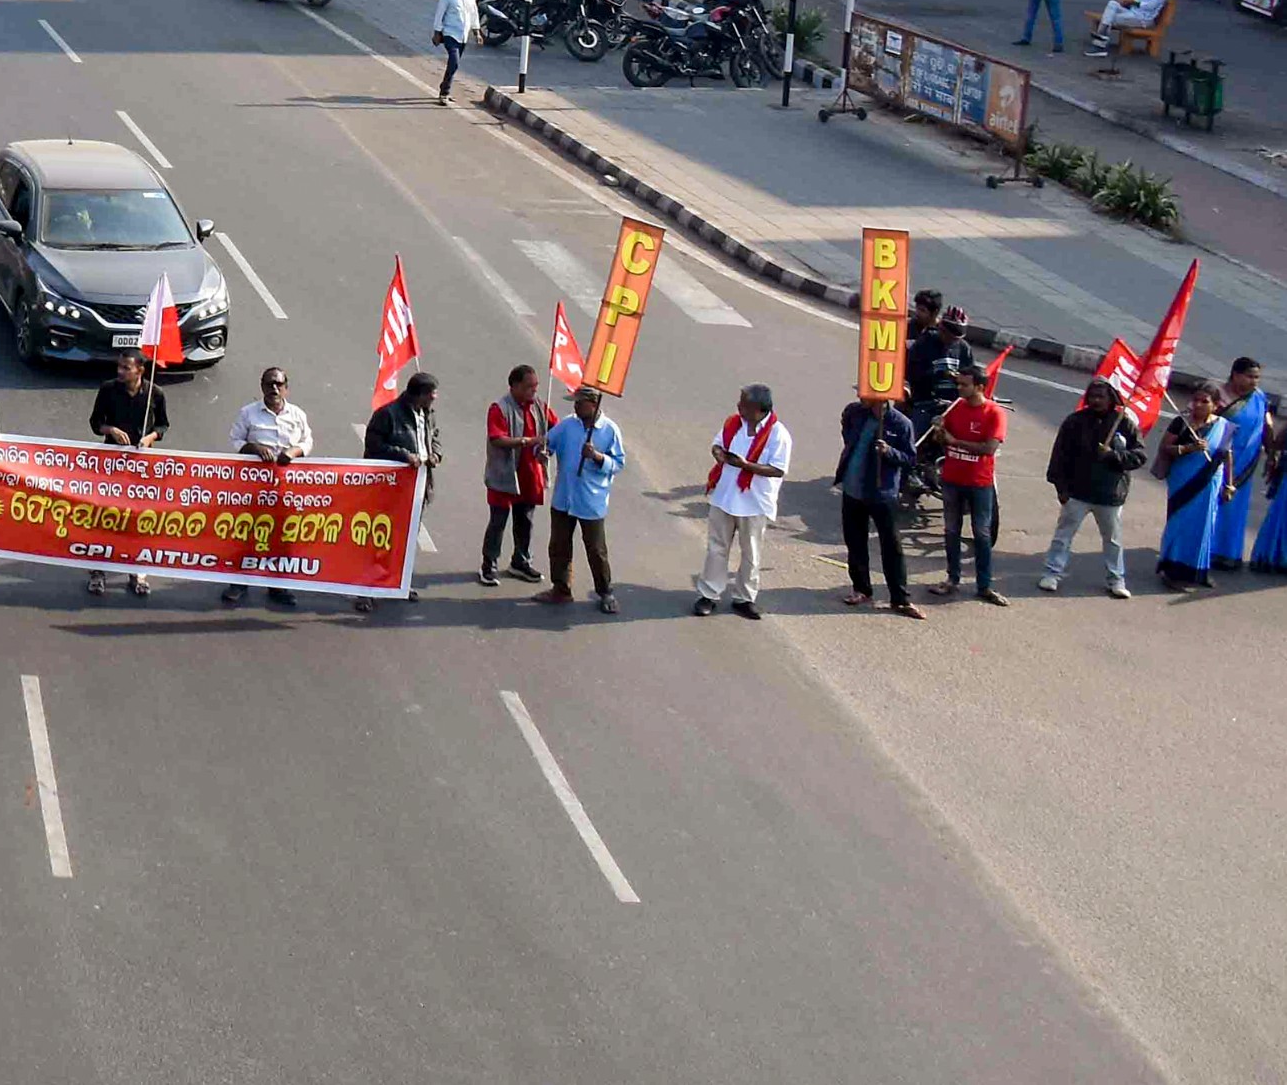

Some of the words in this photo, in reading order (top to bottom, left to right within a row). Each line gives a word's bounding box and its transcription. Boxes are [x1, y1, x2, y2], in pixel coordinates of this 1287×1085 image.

[988, 112, 1020, 137] airtel
[597, 231, 655, 384] CPI
[868, 237, 898, 392] BKMU
[68, 479, 94, 496] ନାମ
[97, 481, 123, 498] ବାଦ
[127, 483, 161, 501] ଦେବା
[165, 487, 175, 502] ଓ
[135, 508, 208, 538] ଭାରତ
[281, 511, 344, 544] ସଫଳ
[68, 542, 113, 561] CPI
[135, 546, 219, 568] AITUC
[240, 556, 321, 576] BKMU
